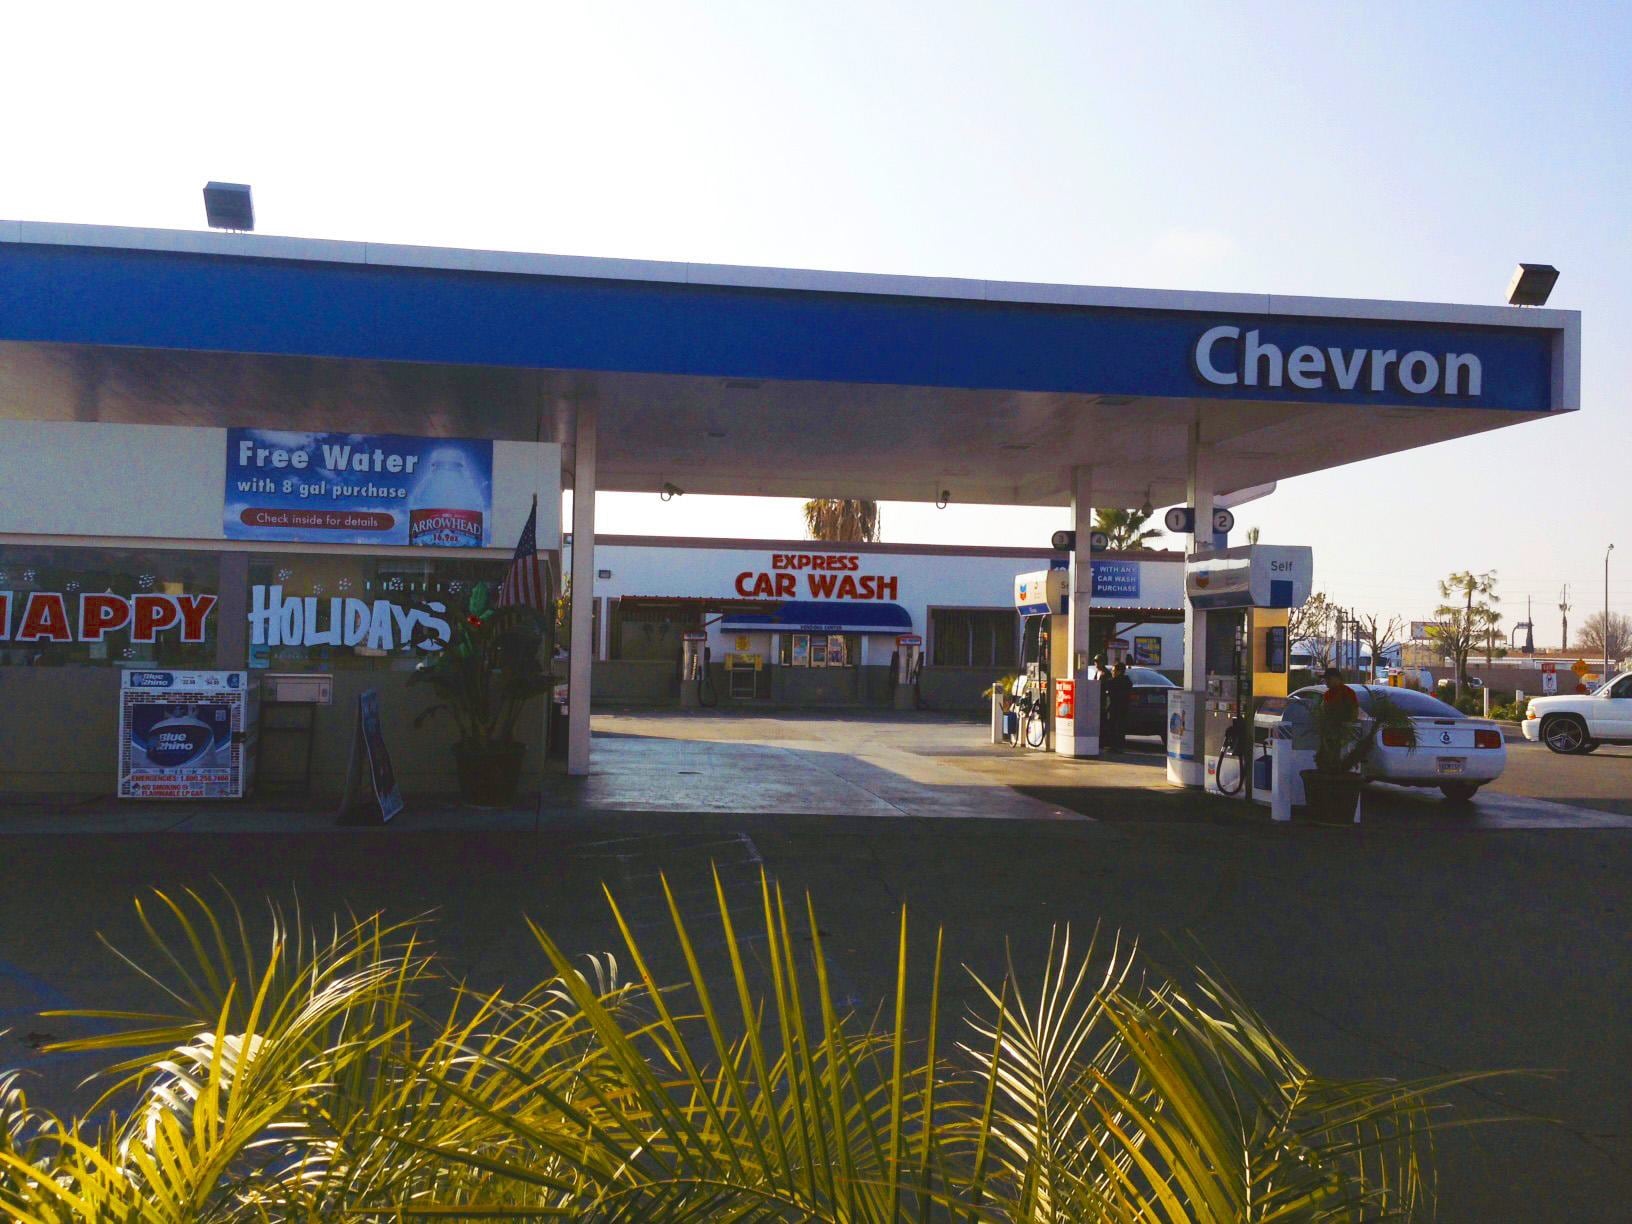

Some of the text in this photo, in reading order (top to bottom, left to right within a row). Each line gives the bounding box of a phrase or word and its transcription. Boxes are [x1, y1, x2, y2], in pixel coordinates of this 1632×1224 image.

[1195, 325, 1482, 396] Chevron
[239, 440, 418, 473] Free Water
[237, 478, 407, 499] with 8 gal purchase
[256, 512, 378, 527] Check inside for details
[411, 515, 481, 535] ARROWHEAD
[1173, 514, 1180, 526] 1
[1218, 515, 1228, 528] 2
[772, 553, 859, 571] EXPRESS
[1271, 560, 1293, 572] Self
[735, 572, 898, 600] CAR WASH
[0, 590, 218, 644] APPY
[248, 584, 451, 651] HOLIDAYS
[159, 733, 187, 741] Blue
